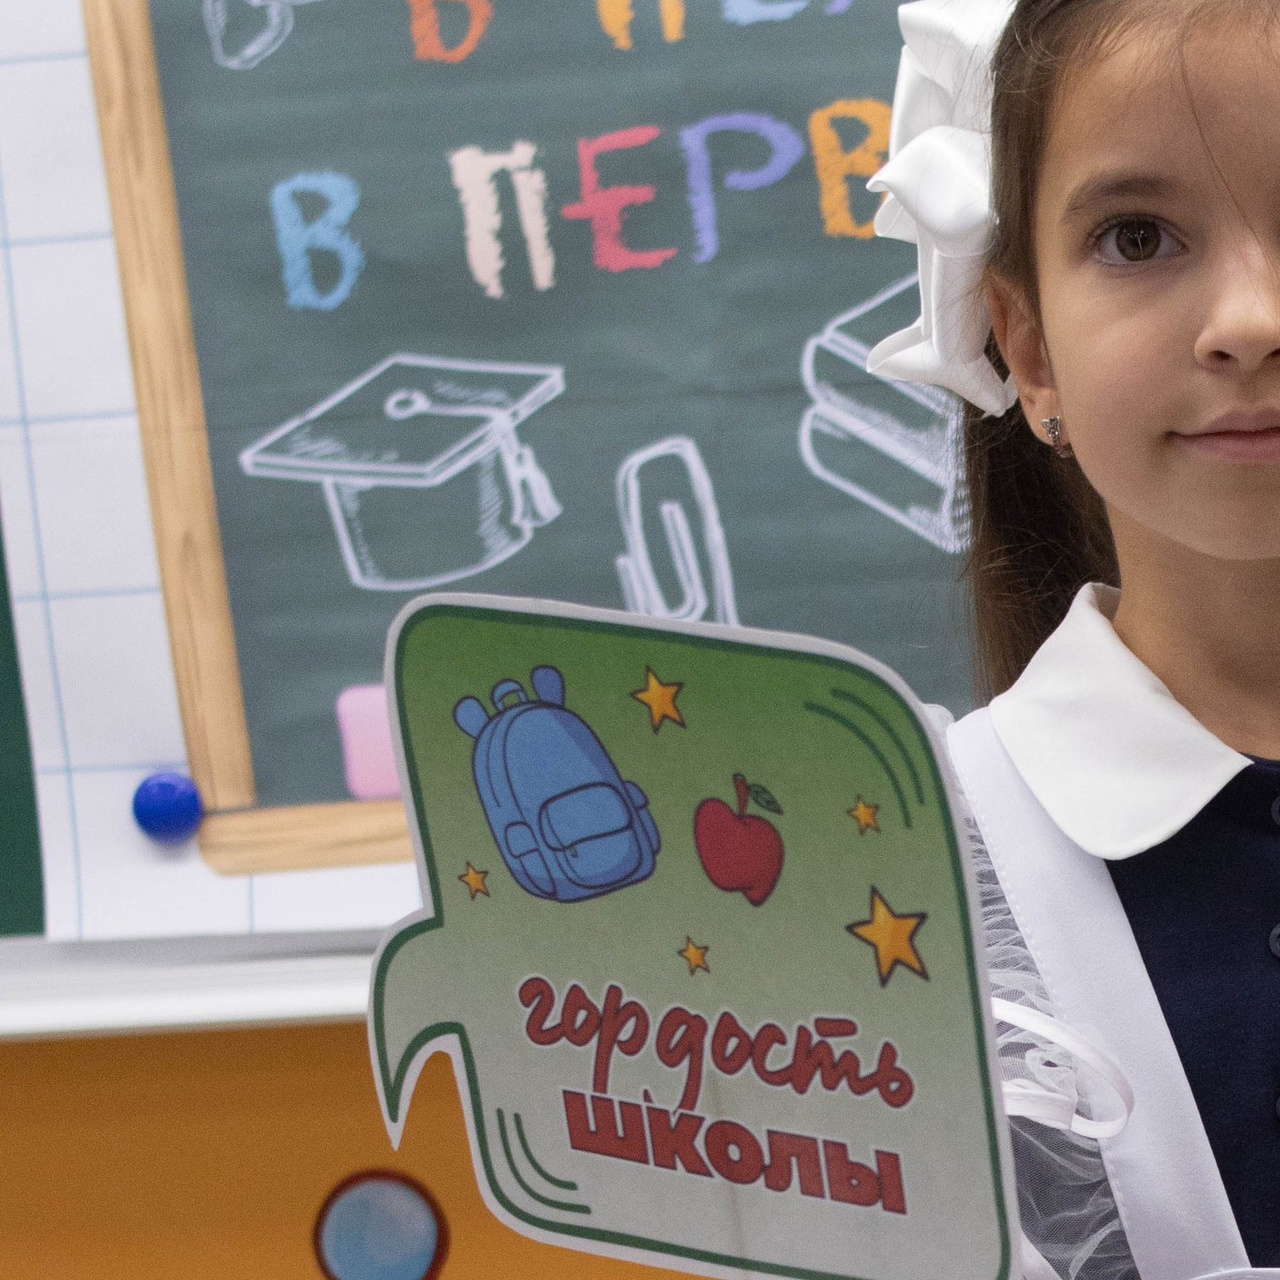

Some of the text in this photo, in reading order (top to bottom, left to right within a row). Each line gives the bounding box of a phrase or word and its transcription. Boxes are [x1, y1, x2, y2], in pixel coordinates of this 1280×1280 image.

[269, 170, 364, 310] В
[447, 98, 892, 298] ПЕРВ
[518, 976, 915, 1109] гордость
